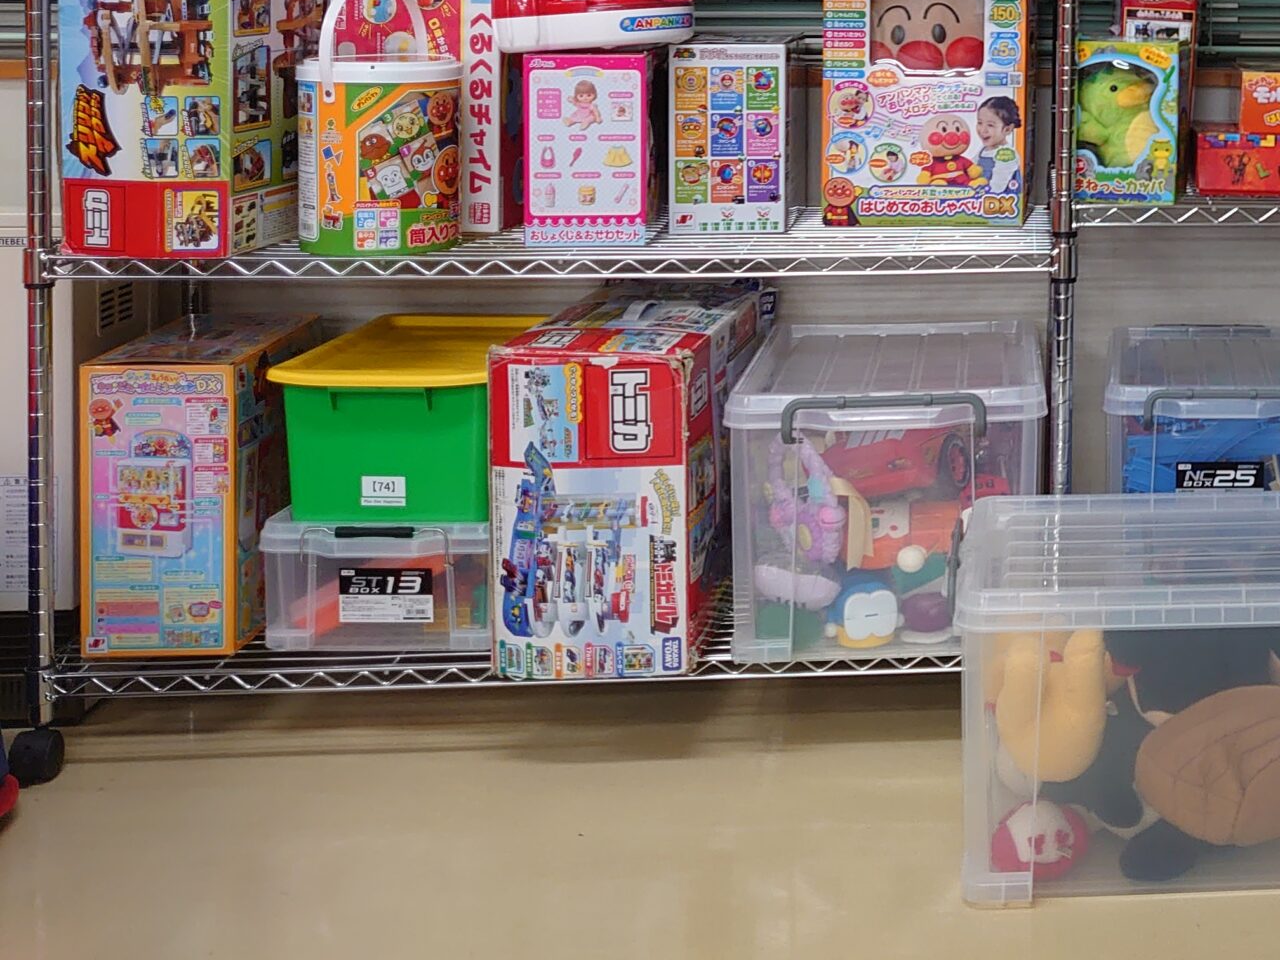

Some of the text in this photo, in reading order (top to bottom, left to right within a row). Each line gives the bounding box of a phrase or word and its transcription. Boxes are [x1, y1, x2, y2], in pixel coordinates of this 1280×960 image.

[469, 12, 492, 194] くるくるチャイム
[83, 188, 112, 248] トミカ
[530, 229, 641, 241] おしょくじ&おせわセット
[610, 368, 652, 453] トミカ
[373, 481, 395, 492] 【74】
[1213, 470, 1257, 487] 25
[351, 576, 422, 594] ST 13
[655, 563, 678, 623] トミカビル
[664, 640, 673, 668] TOMY
